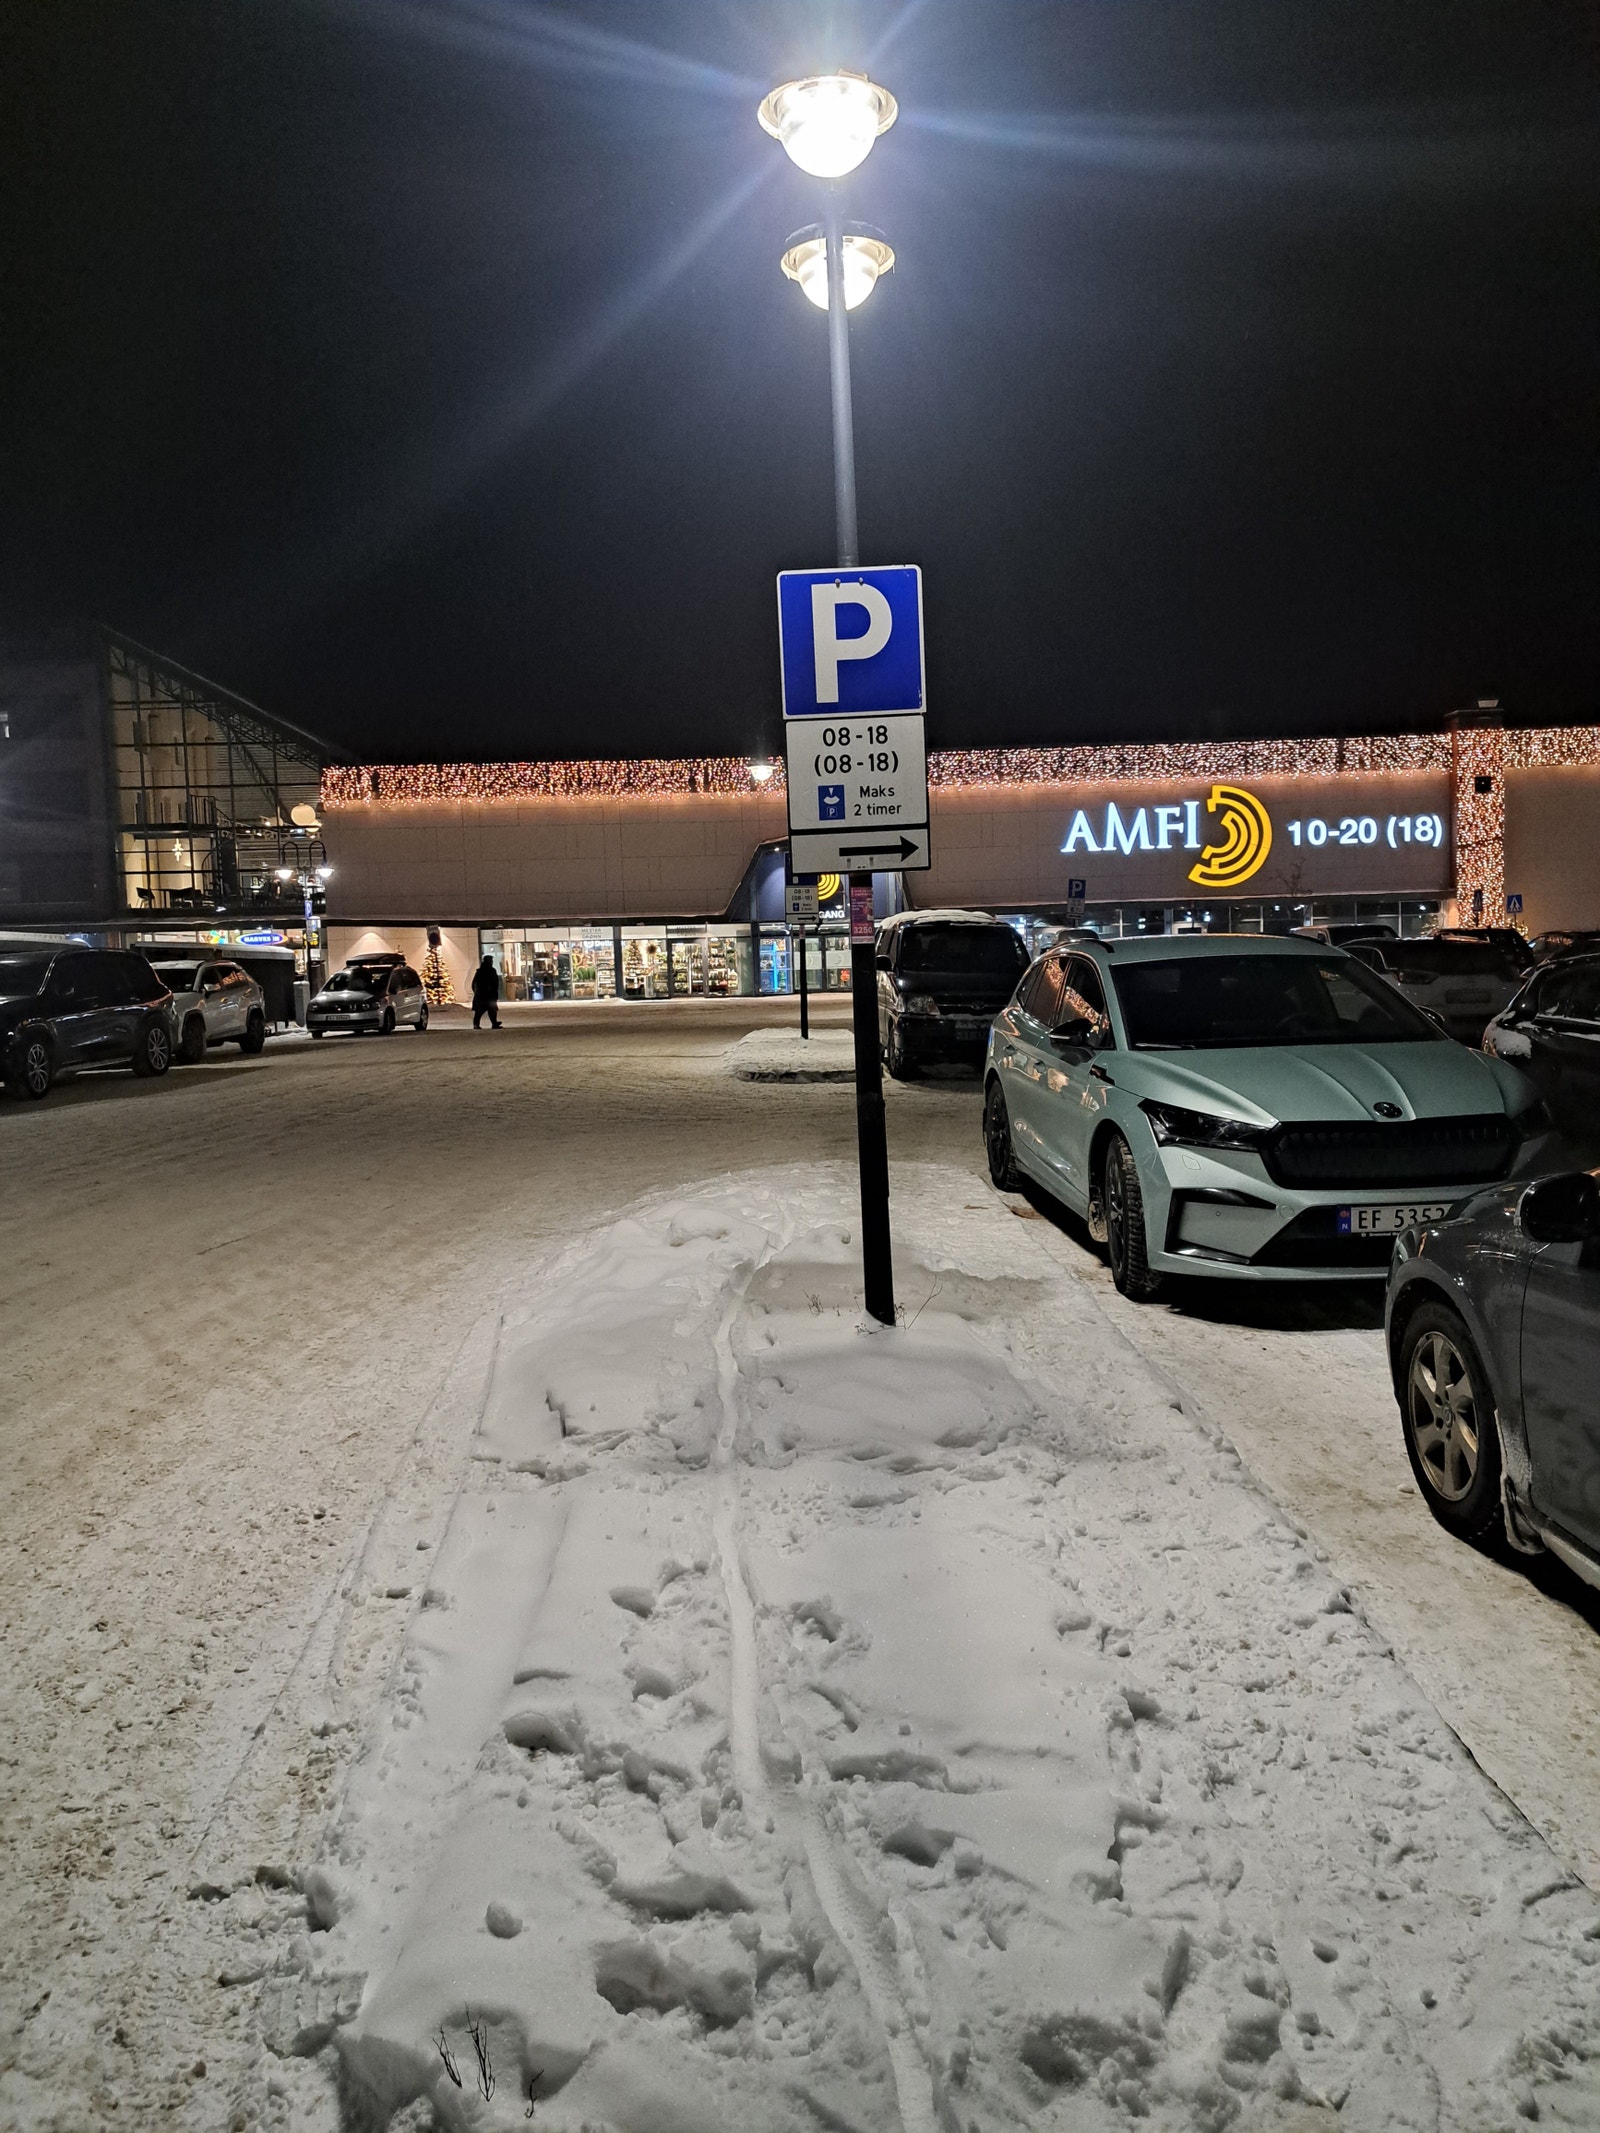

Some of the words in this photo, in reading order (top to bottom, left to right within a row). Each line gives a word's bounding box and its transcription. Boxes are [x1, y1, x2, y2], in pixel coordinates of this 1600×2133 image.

[811, 582, 892, 703] P
[860, 785, 895, 798] Maks
[853, 803, 862, 816] 2
[866, 803, 902, 816] timer
[1060, 800, 1202, 855] AMFI
[1287, 816, 1378, 847] 10-20
[1387, 815, 1443, 849] (18)
[1072, 881, 1082, 896] P
[819, 910, 845, 918] GANG
[1358, 1210, 1381, 1229] EF
